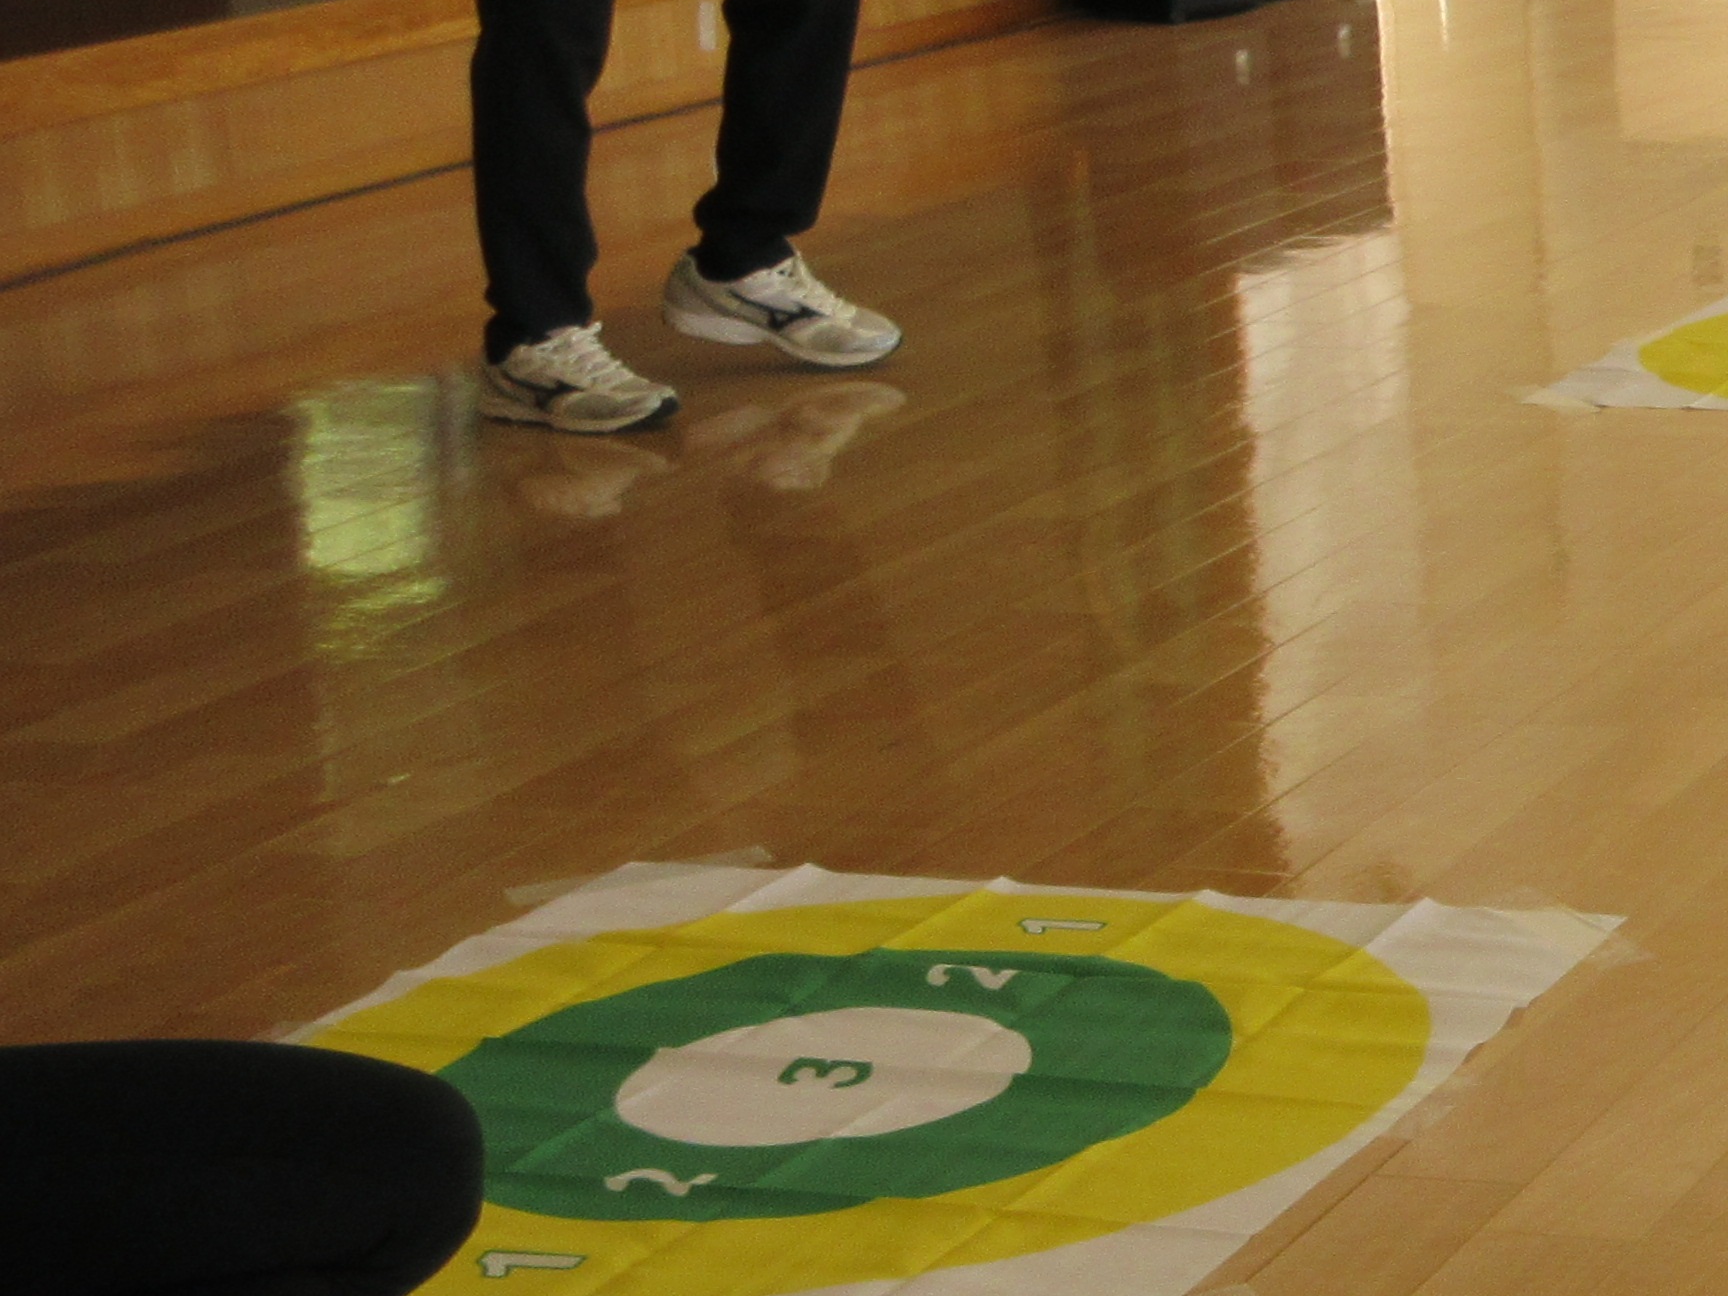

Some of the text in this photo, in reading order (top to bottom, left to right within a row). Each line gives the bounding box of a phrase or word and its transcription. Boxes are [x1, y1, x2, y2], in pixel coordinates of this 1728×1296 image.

[1017, 917, 1107, 935] 1
[926, 963, 1021, 991] 2
[777, 1055, 874, 1090] 3
[604, 1167, 719, 1197] 2
[477, 1249, 588, 1279] 1
